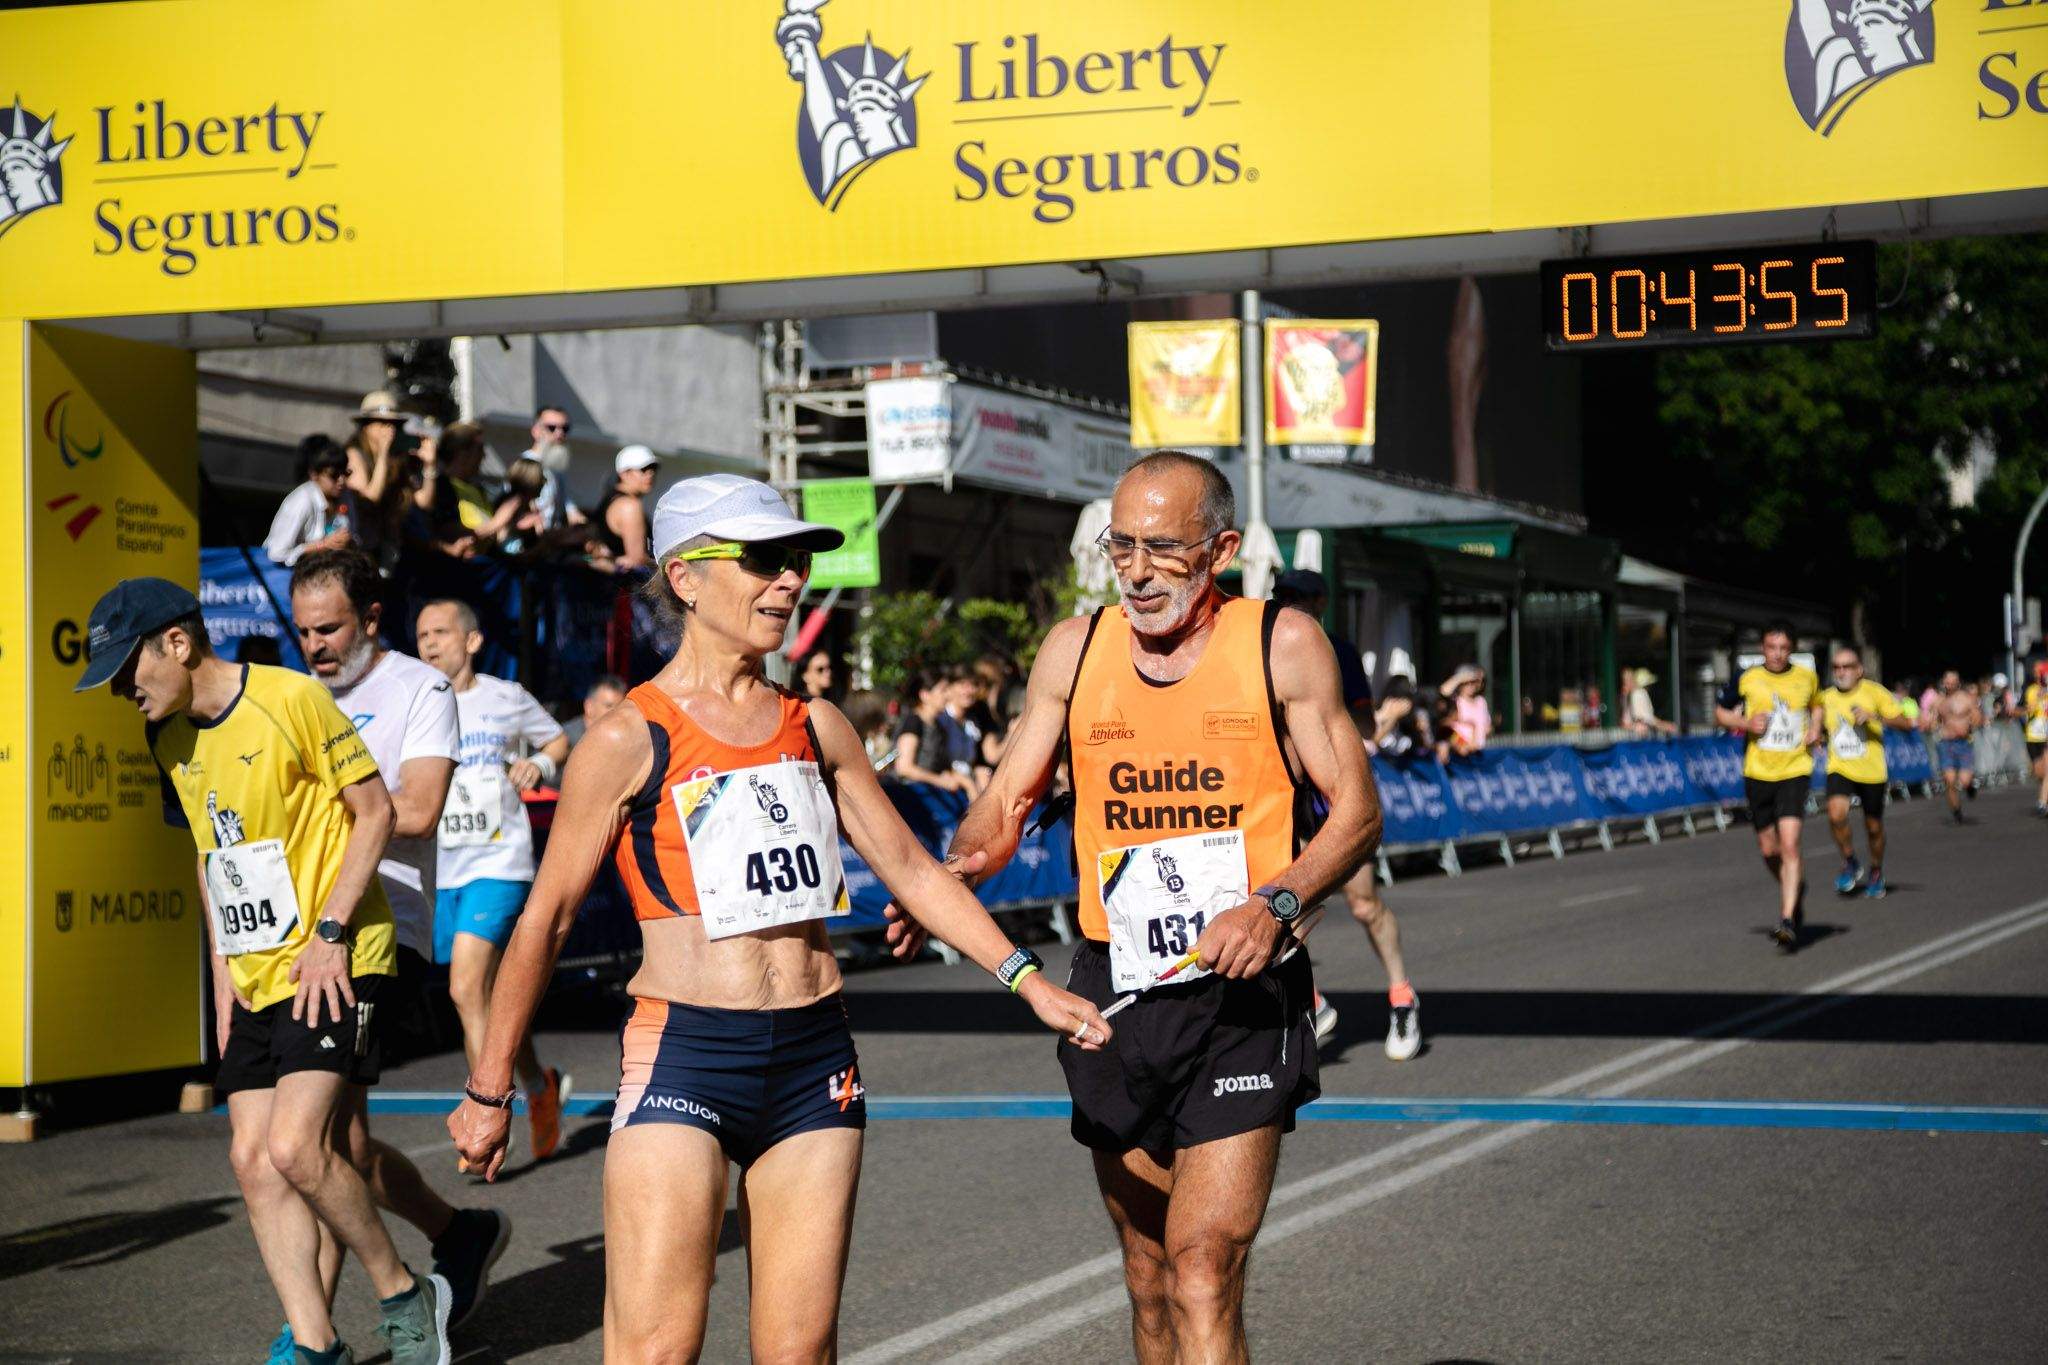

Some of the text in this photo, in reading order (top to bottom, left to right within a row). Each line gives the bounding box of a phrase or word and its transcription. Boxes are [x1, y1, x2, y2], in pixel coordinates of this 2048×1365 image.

[953, 33, 1228, 118] Liberty
[94, 99, 326, 179] Liberty
[953, 140, 1242, 224] Seguros
[93, 198, 341, 277] Seguros
[1562, 256, 1849, 342] 00:43:55
[199, 578, 270, 614] iberty
[52, 618, 90, 667] G
[1089, 728, 1136, 741] Athletics
[1108, 759, 1225, 795] Guide
[49, 803, 111, 822] MADRID
[443, 811, 487, 834] 1339
[771, 807, 786, 820] 13
[1103, 799, 1244, 832] Runner
[745, 843, 822, 897] 430
[1168, 877, 1182, 890] 13
[89, 890, 186, 925] MADRID
[642, 1094, 721, 1126] ANQUOR
